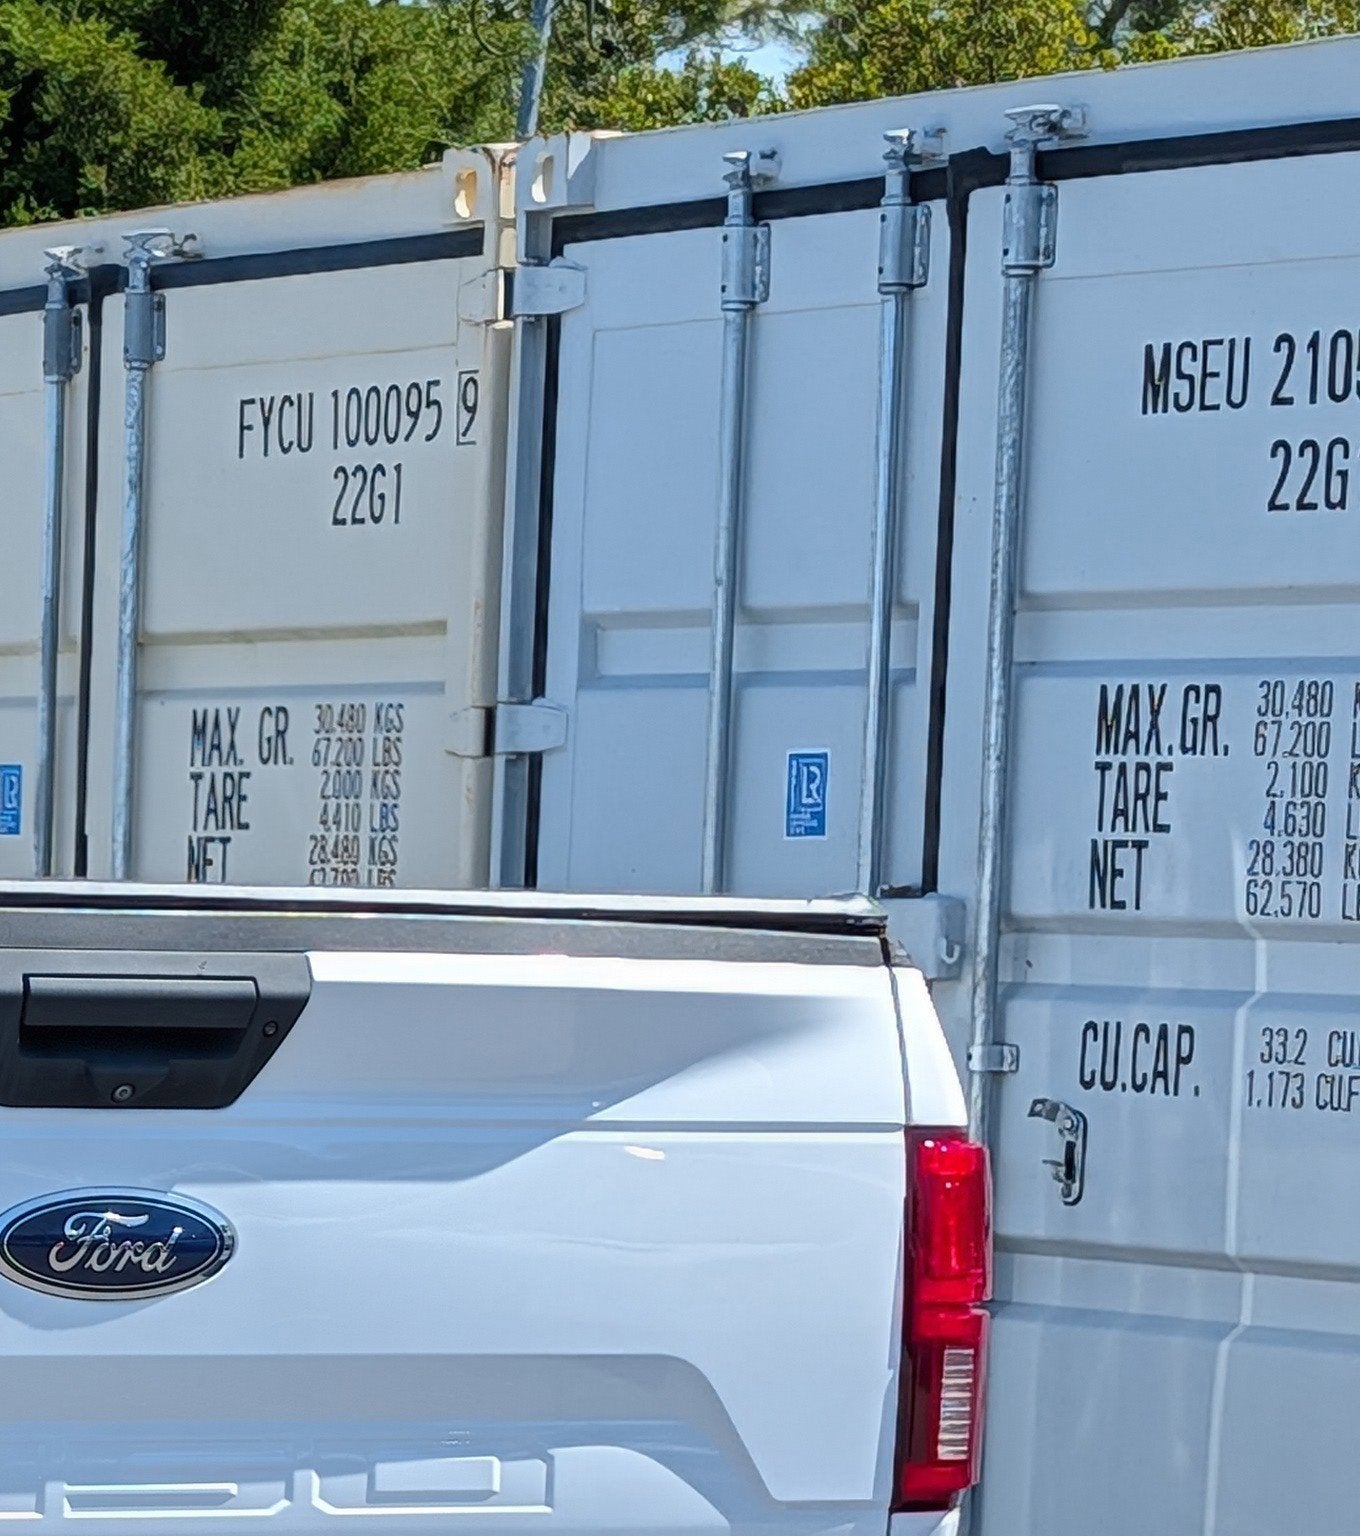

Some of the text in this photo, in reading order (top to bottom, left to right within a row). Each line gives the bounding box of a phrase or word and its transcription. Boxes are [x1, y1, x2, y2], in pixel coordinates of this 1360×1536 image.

[1141, 328, 1360, 415] MSEU 210
[239, 392, 314, 459] FYCU
[331, 379, 443, 450] 100095
[332, 463, 402, 526] 22G1
[258, 706, 294, 766] GR.
[372, 736, 402, 767] LBS
[190, 771, 251, 831] TARE
[370, 769, 401, 800] KGS
[370, 802, 399, 833] LBS
[1094, 762, 1173, 833] TARE
[187, 835, 231, 884] NET
[368, 834, 398, 866] KGS
[1088, 839, 1149, 910] NET
[48, 1210, 184, 1274] Ford
